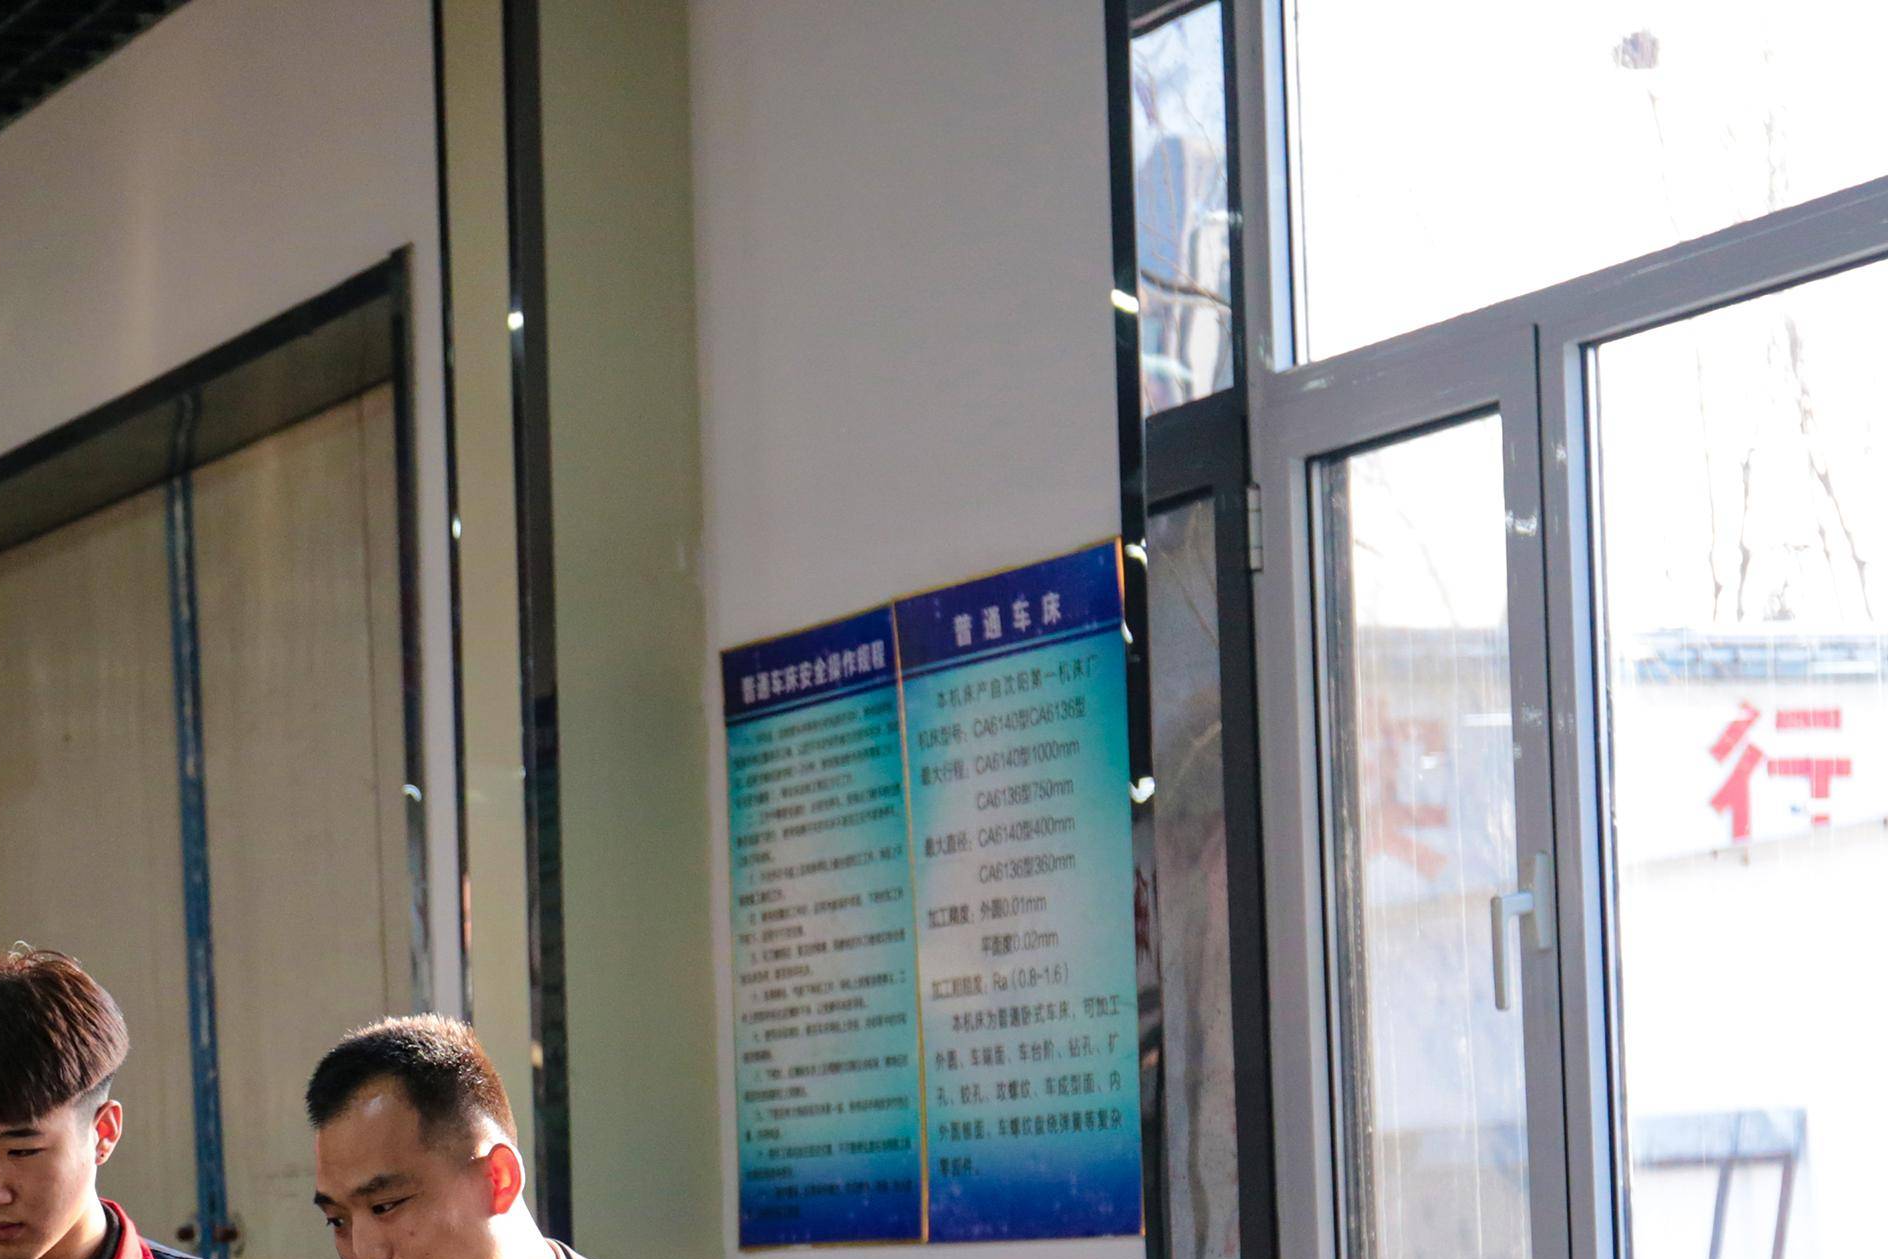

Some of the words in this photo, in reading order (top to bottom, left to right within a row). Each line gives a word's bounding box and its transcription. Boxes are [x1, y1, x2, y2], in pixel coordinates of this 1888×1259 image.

[954, 592, 1062, 647] 普通车床
[1709, 700, 1852, 843] 行
